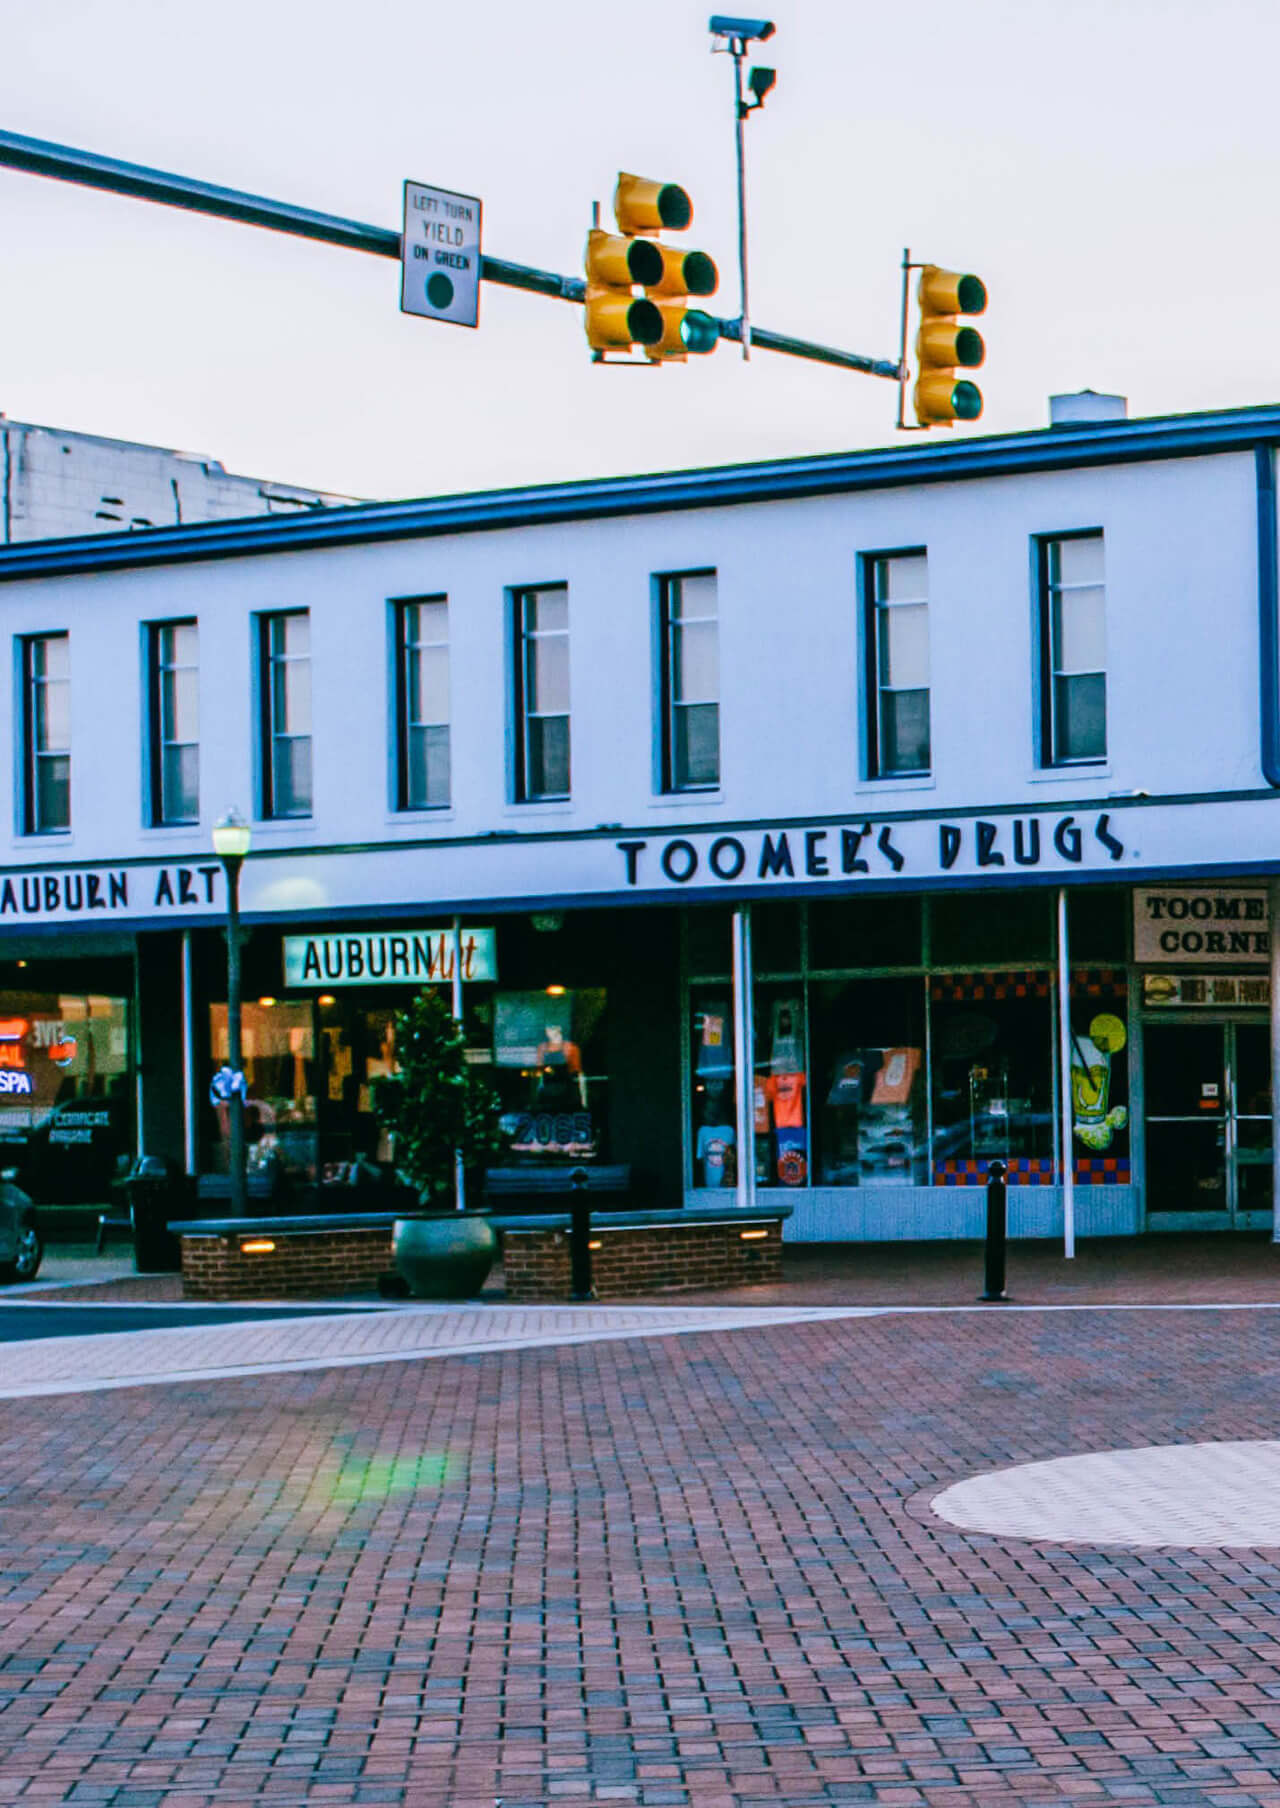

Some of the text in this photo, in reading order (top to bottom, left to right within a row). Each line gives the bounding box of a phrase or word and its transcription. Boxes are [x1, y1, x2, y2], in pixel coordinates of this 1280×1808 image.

[414, 194, 473, 221] LEFT TURN
[422, 220, 464, 247] YIELD
[413, 244, 471, 270] ON GREEN
[617, 813, 1126, 885] TOOMER'S DRUGS
[0, 866, 221, 915] AUBURN ART
[303, 935, 433, 980] AUBURN
[0, 1070, 31, 1094] SPA
